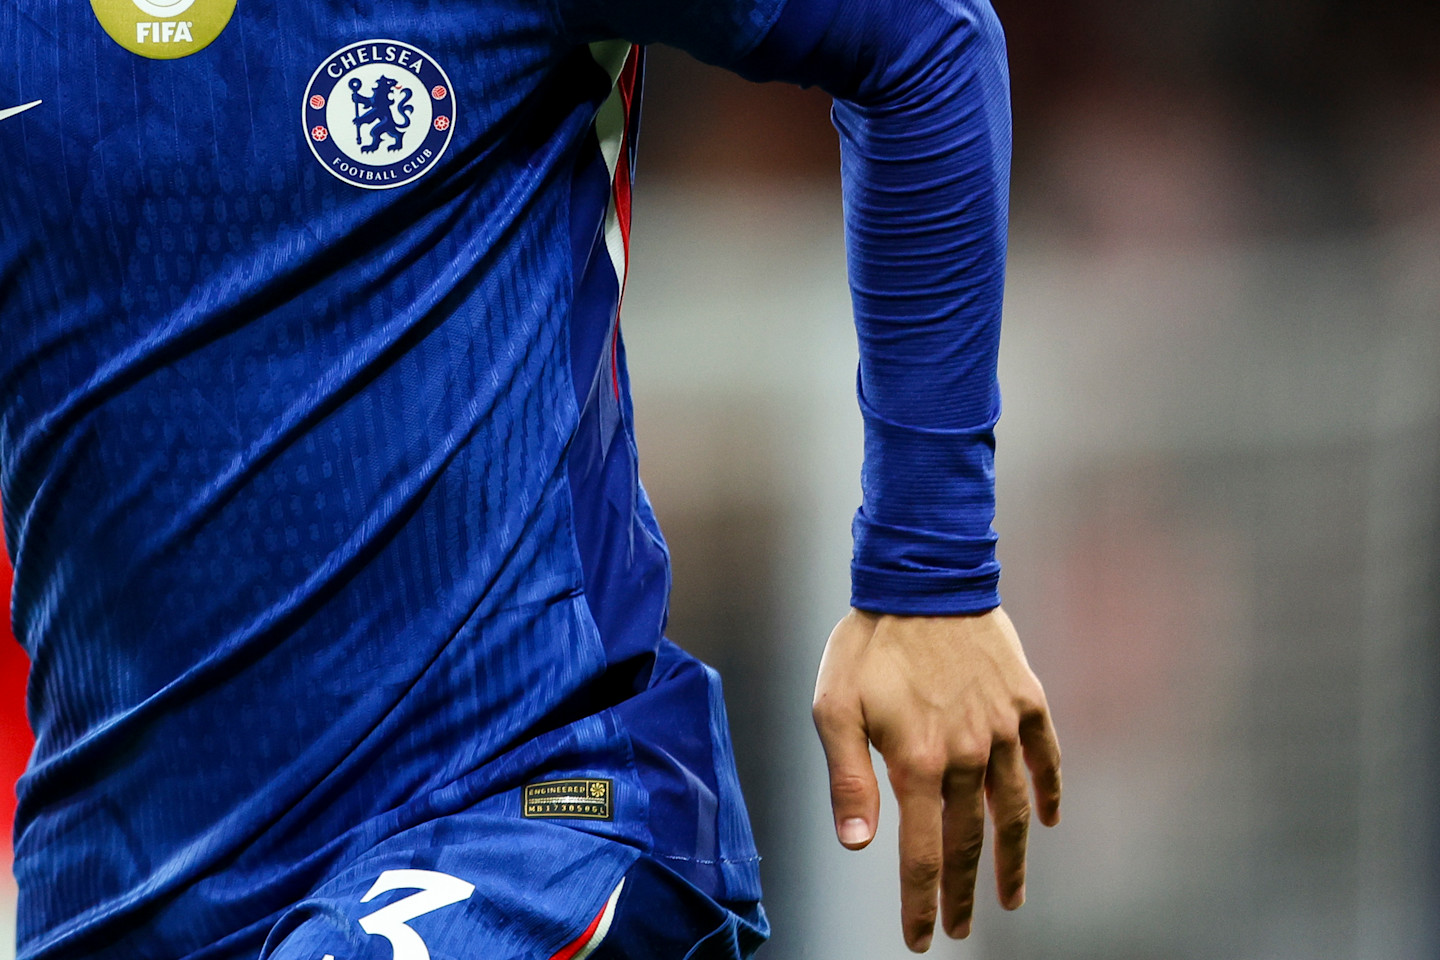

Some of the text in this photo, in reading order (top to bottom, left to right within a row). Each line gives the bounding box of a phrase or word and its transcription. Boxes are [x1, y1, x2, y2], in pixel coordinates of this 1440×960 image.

[136, 21, 194, 44] FIFA
[327, 46, 424, 78] CHELSEA
[332, 148, 433, 181] FOOTBALL CLUB
[529, 786, 586, 796] ENGINEERED
[321, 869, 476, 960] 3
